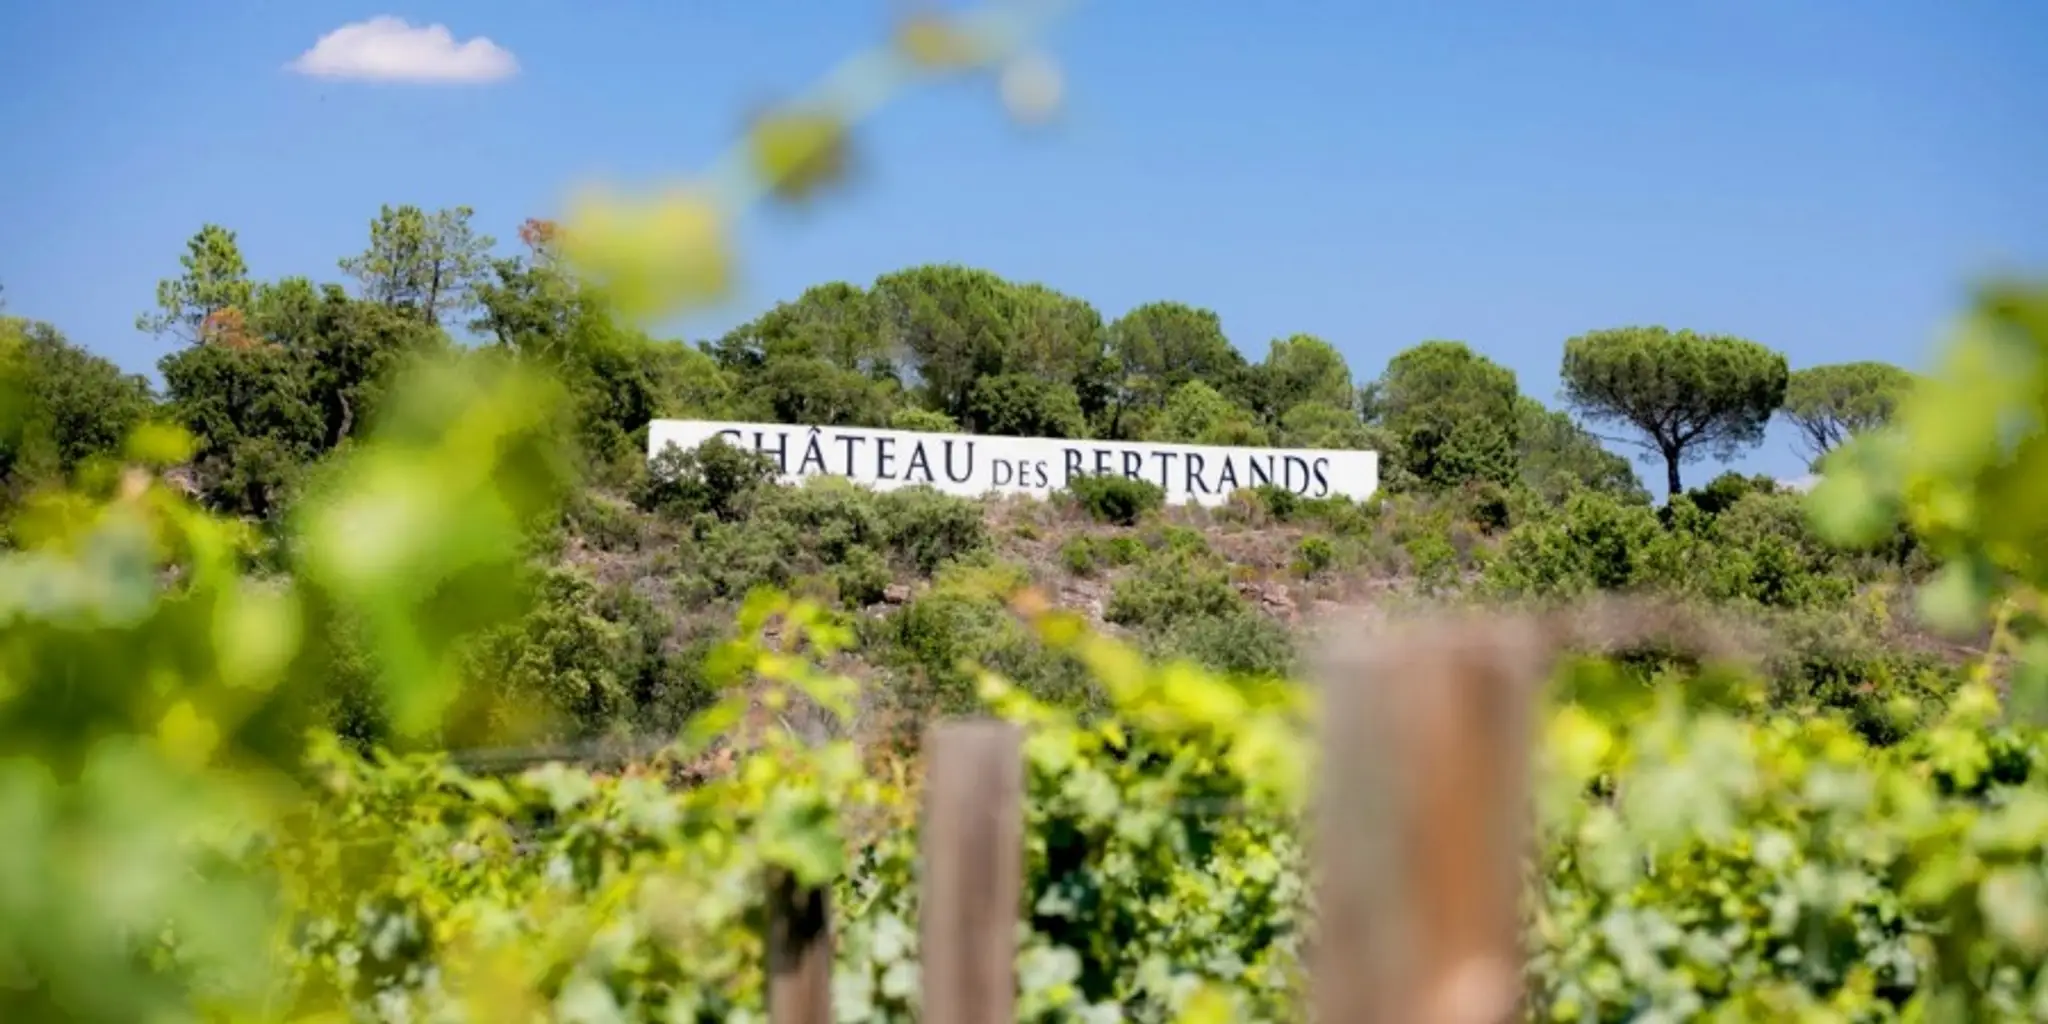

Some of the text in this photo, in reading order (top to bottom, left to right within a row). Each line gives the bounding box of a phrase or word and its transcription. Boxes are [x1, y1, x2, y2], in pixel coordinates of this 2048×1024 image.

[716, 425, 1330, 498] HÂTEAU DES BERTRANDS
